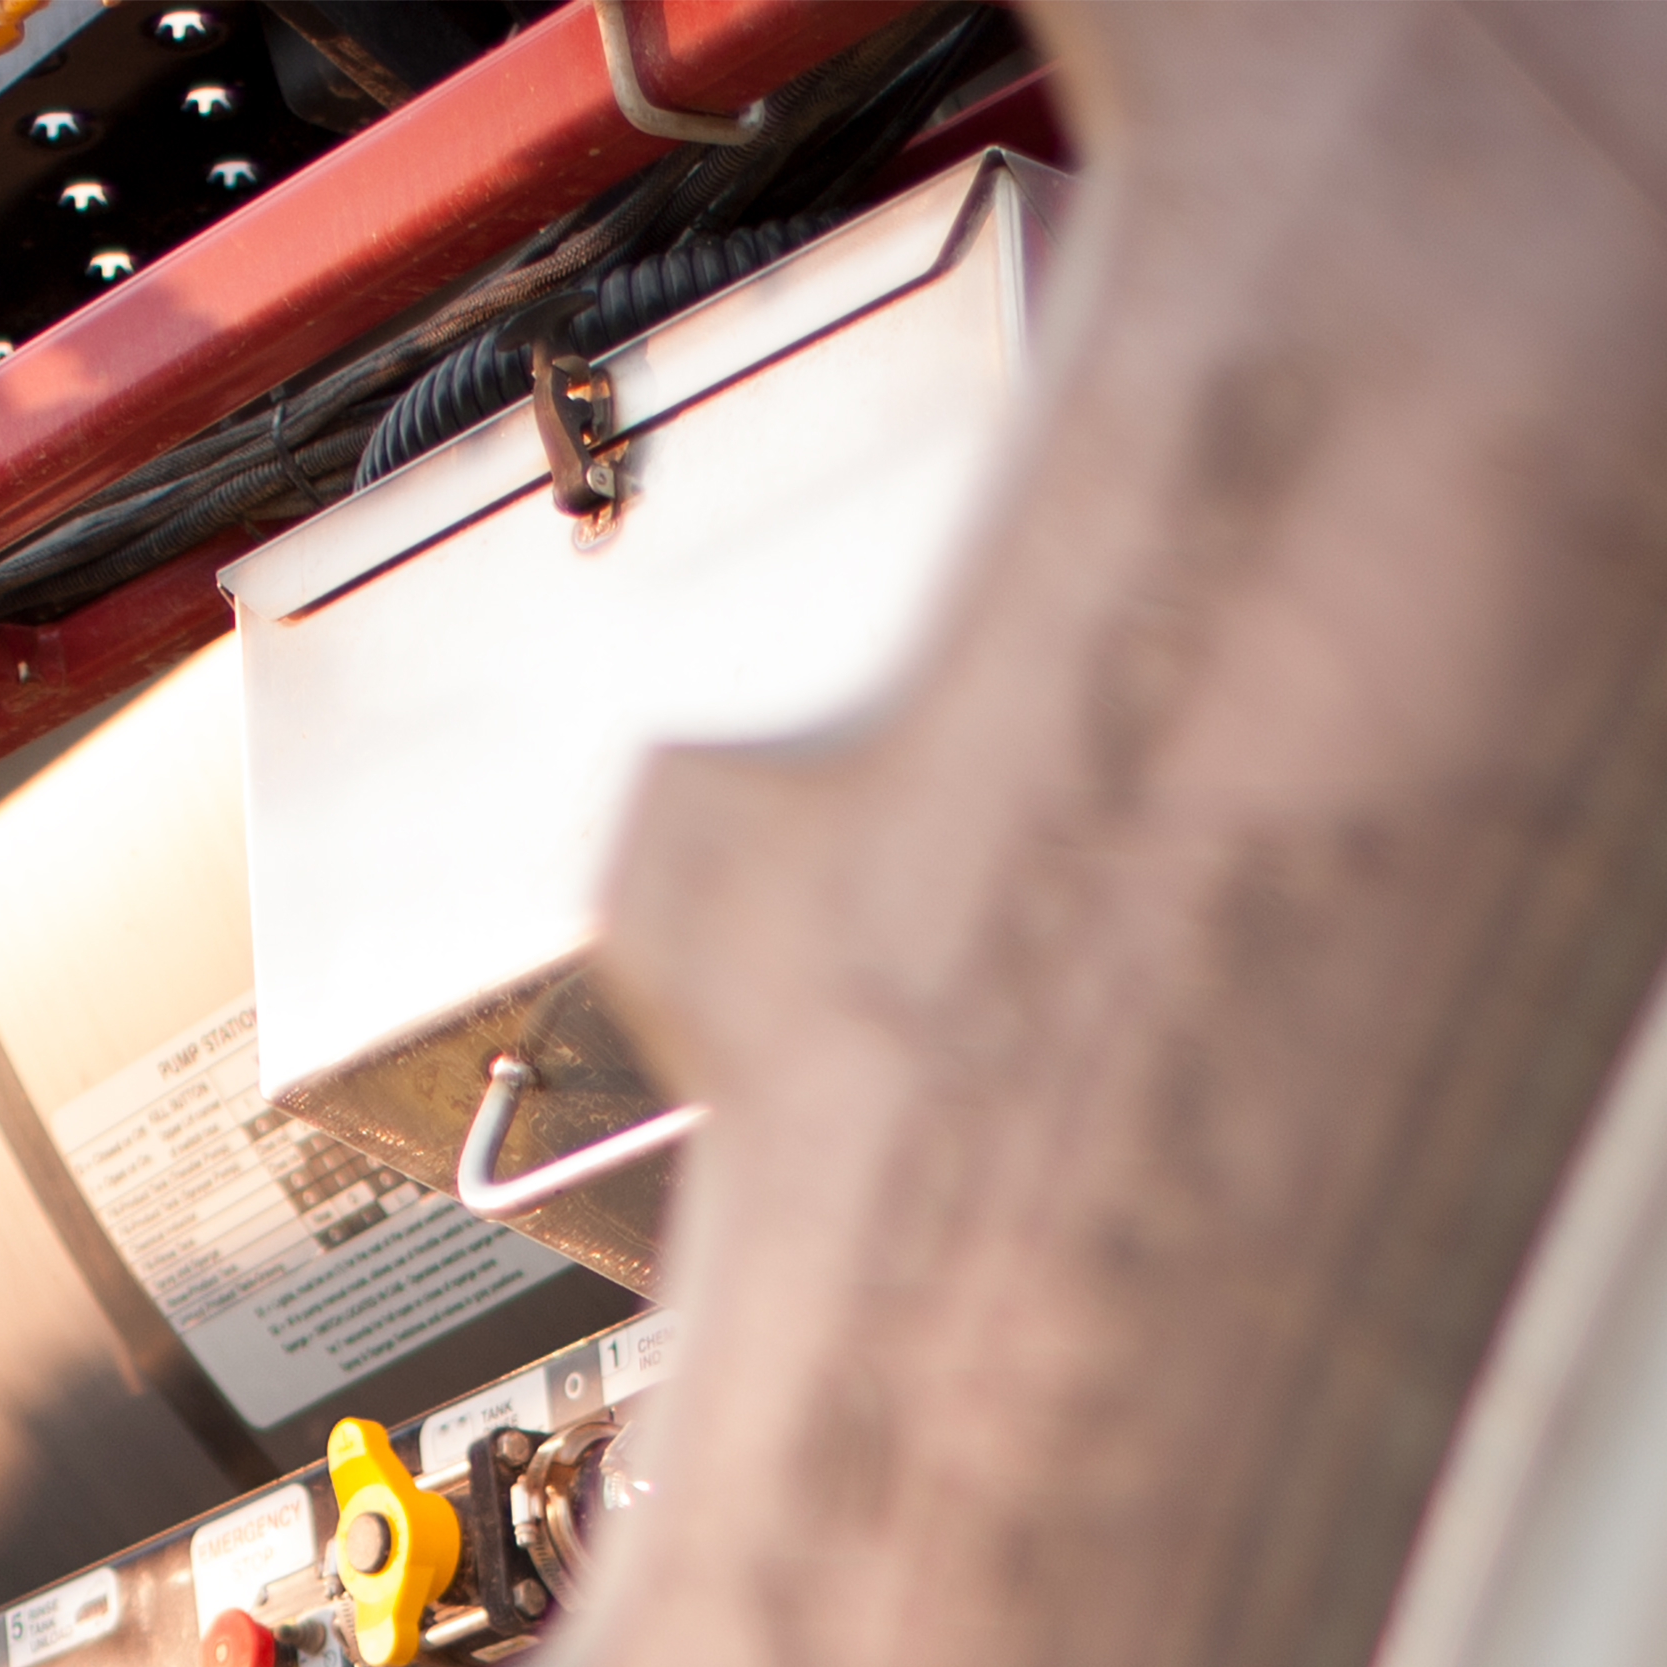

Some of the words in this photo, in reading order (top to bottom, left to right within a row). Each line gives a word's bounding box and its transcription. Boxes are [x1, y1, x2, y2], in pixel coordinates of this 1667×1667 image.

[158, 1043, 199, 1080] PUMP
[607, 1338, 621, 1369] 1
[564, 1371, 584, 1401] 0
[481, 1397, 514, 1423] TANK
[196, 1498, 302, 1565] EMERGENCY
[232, 1545, 274, 1582] STOP
[11, 1612, 24, 1640] 5
